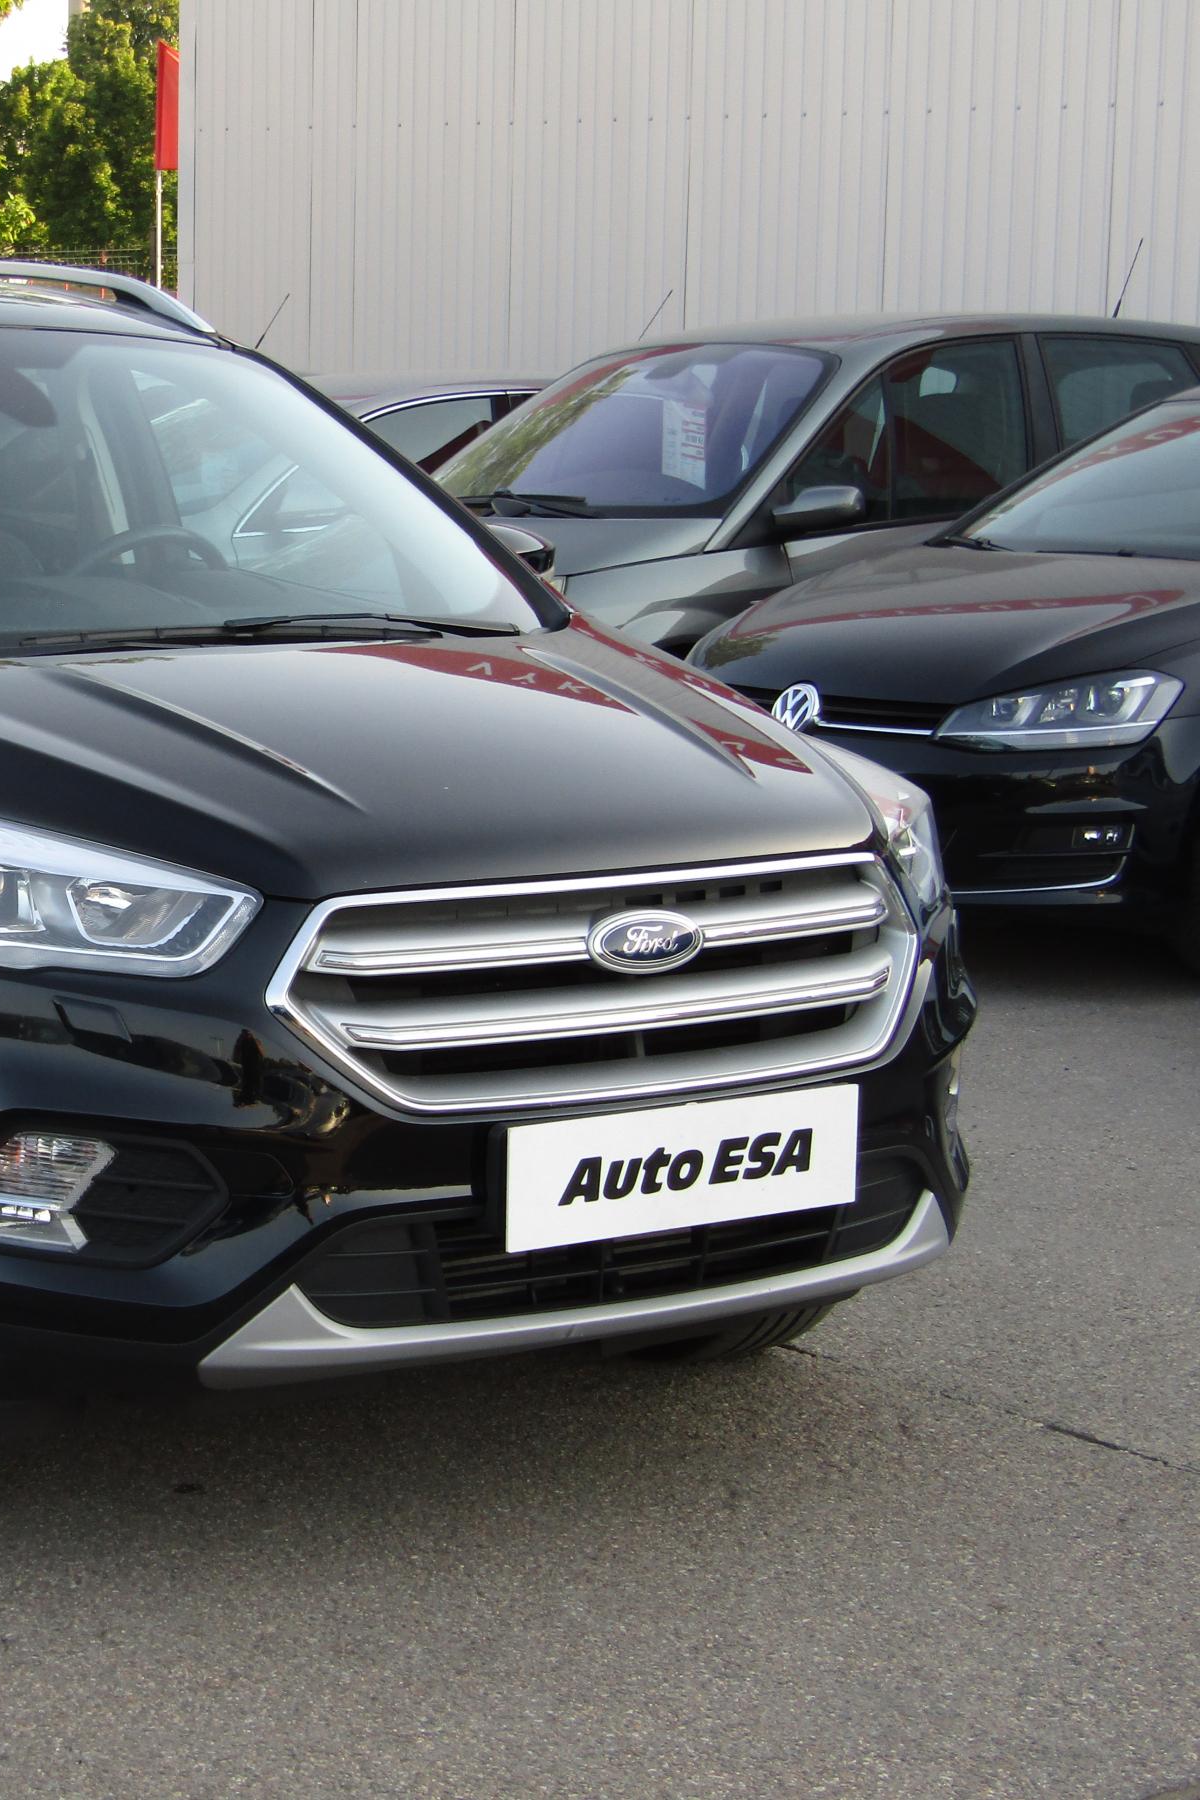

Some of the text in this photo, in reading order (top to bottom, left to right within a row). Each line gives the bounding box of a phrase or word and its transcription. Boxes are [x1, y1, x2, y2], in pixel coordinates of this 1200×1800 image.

[622, 925, 680, 954] Ford
[557, 1127, 813, 1206] Auto ESA
